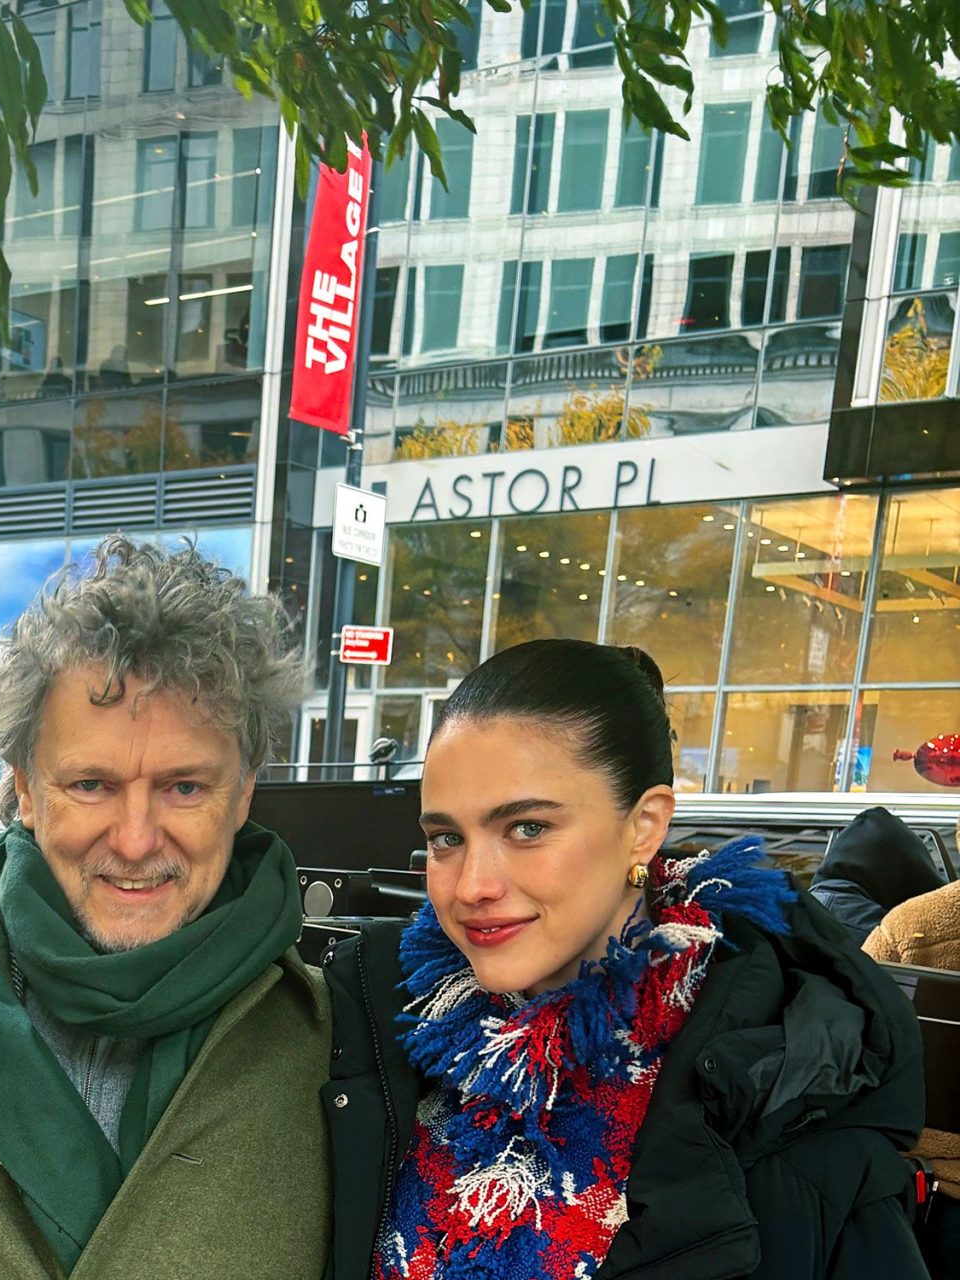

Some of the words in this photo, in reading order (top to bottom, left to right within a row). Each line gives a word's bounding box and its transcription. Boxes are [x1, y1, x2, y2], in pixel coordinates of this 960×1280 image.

[304, 269, 338, 369] THE
[324, 168, 364, 375] VILLAGE
[410, 465, 582, 523] ASTOR
[613, 457, 662, 510] PL
